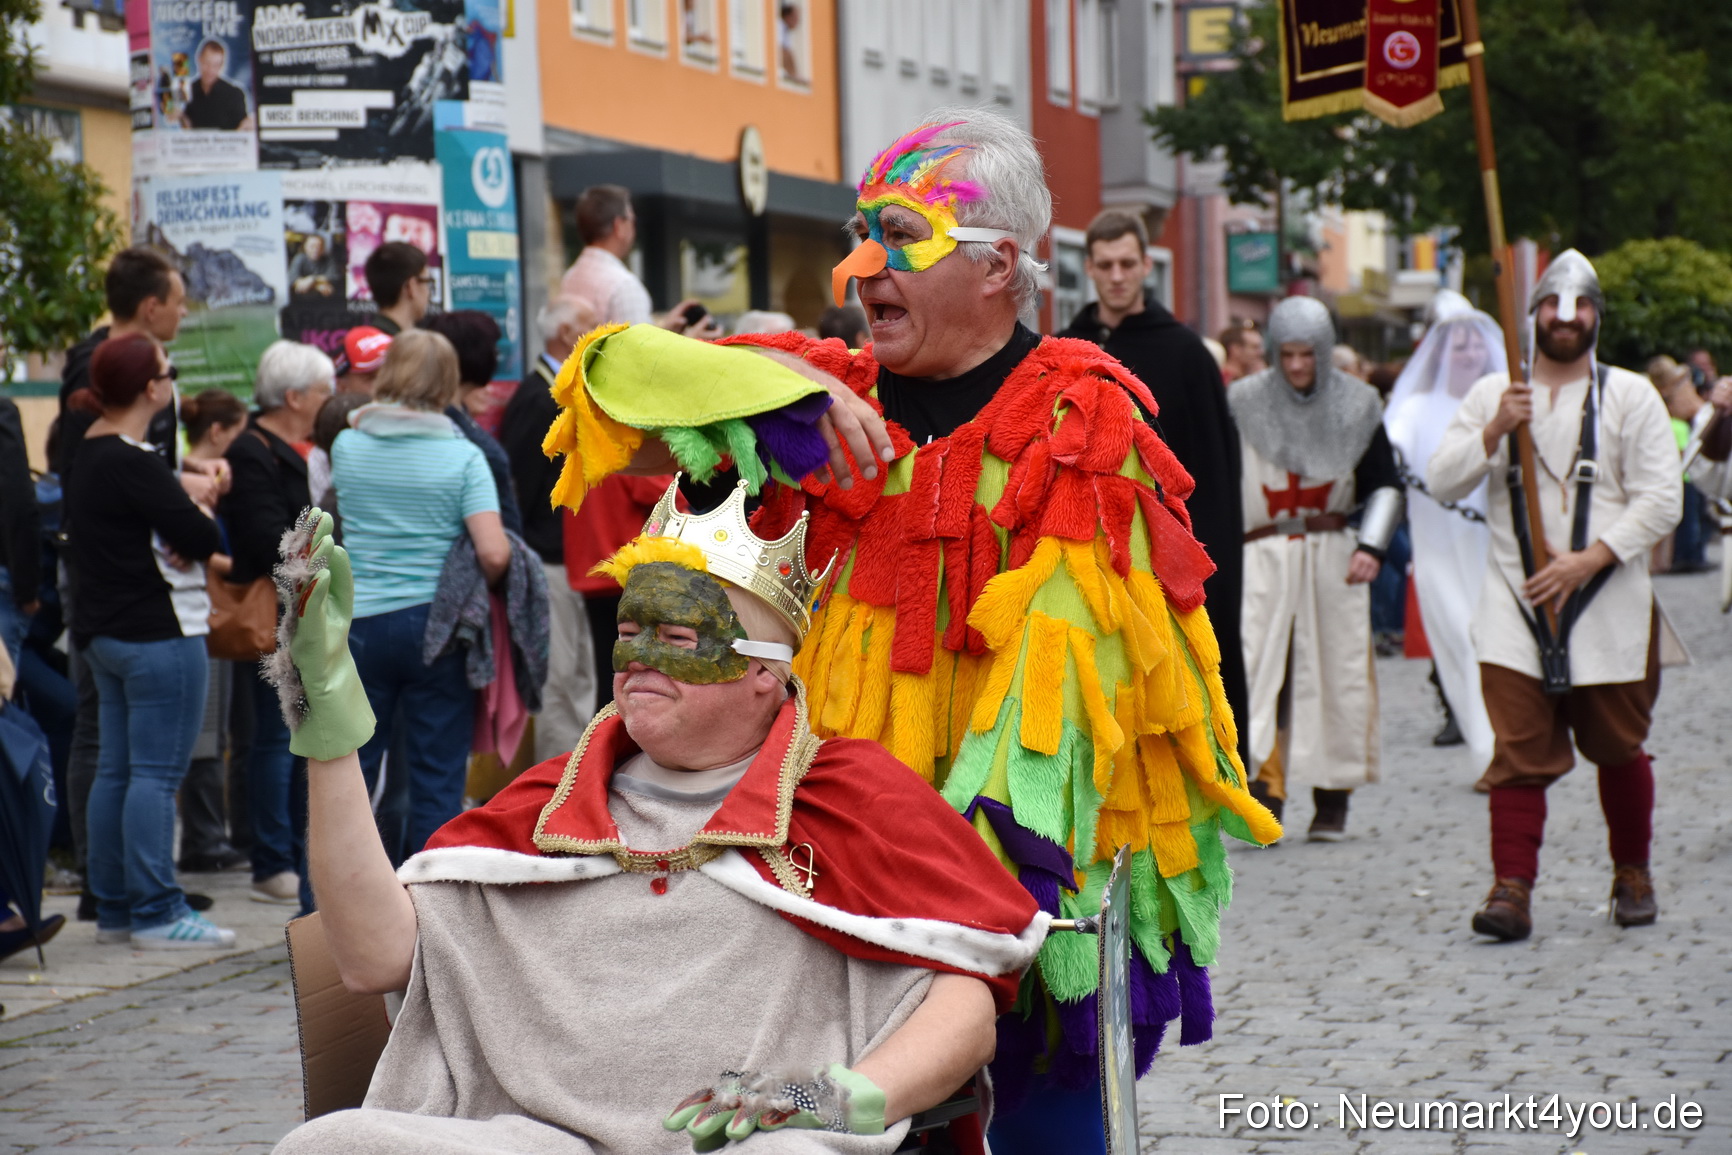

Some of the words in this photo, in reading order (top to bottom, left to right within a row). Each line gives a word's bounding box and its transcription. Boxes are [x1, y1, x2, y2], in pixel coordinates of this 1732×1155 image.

[254, 4, 306, 25] ADAC
[256, 22, 356, 47] NORDBAYERN
[403, 14, 428, 35] CUP
[272, 46, 349, 66] MOTOCROSS
[266, 110, 292, 123] MSC
[297, 109, 360, 123] BERCHING
